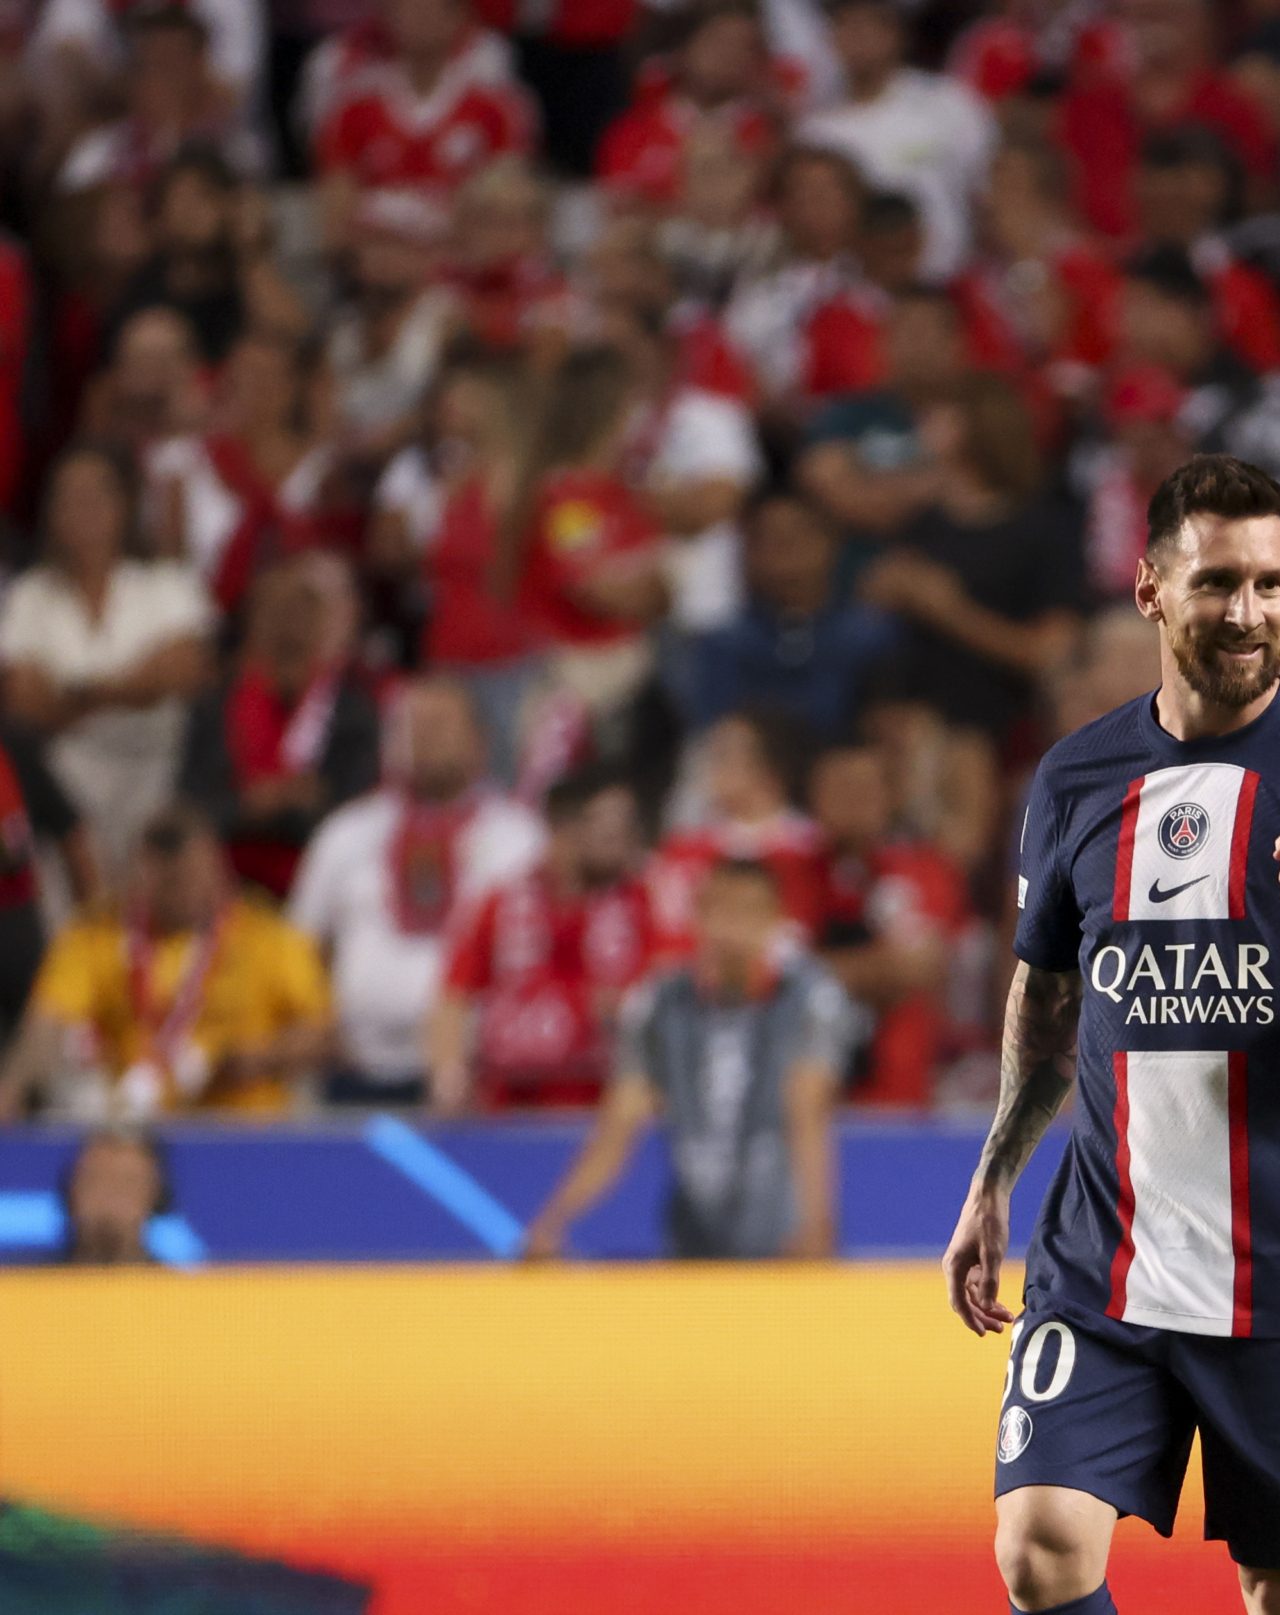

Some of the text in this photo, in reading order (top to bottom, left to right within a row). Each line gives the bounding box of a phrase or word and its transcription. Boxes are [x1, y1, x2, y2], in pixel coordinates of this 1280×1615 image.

[1169, 806, 1202, 820] PARIS
[1091, 943, 1274, 1003] QATAR
[1125, 995, 1275, 1025] AIRWAYS
